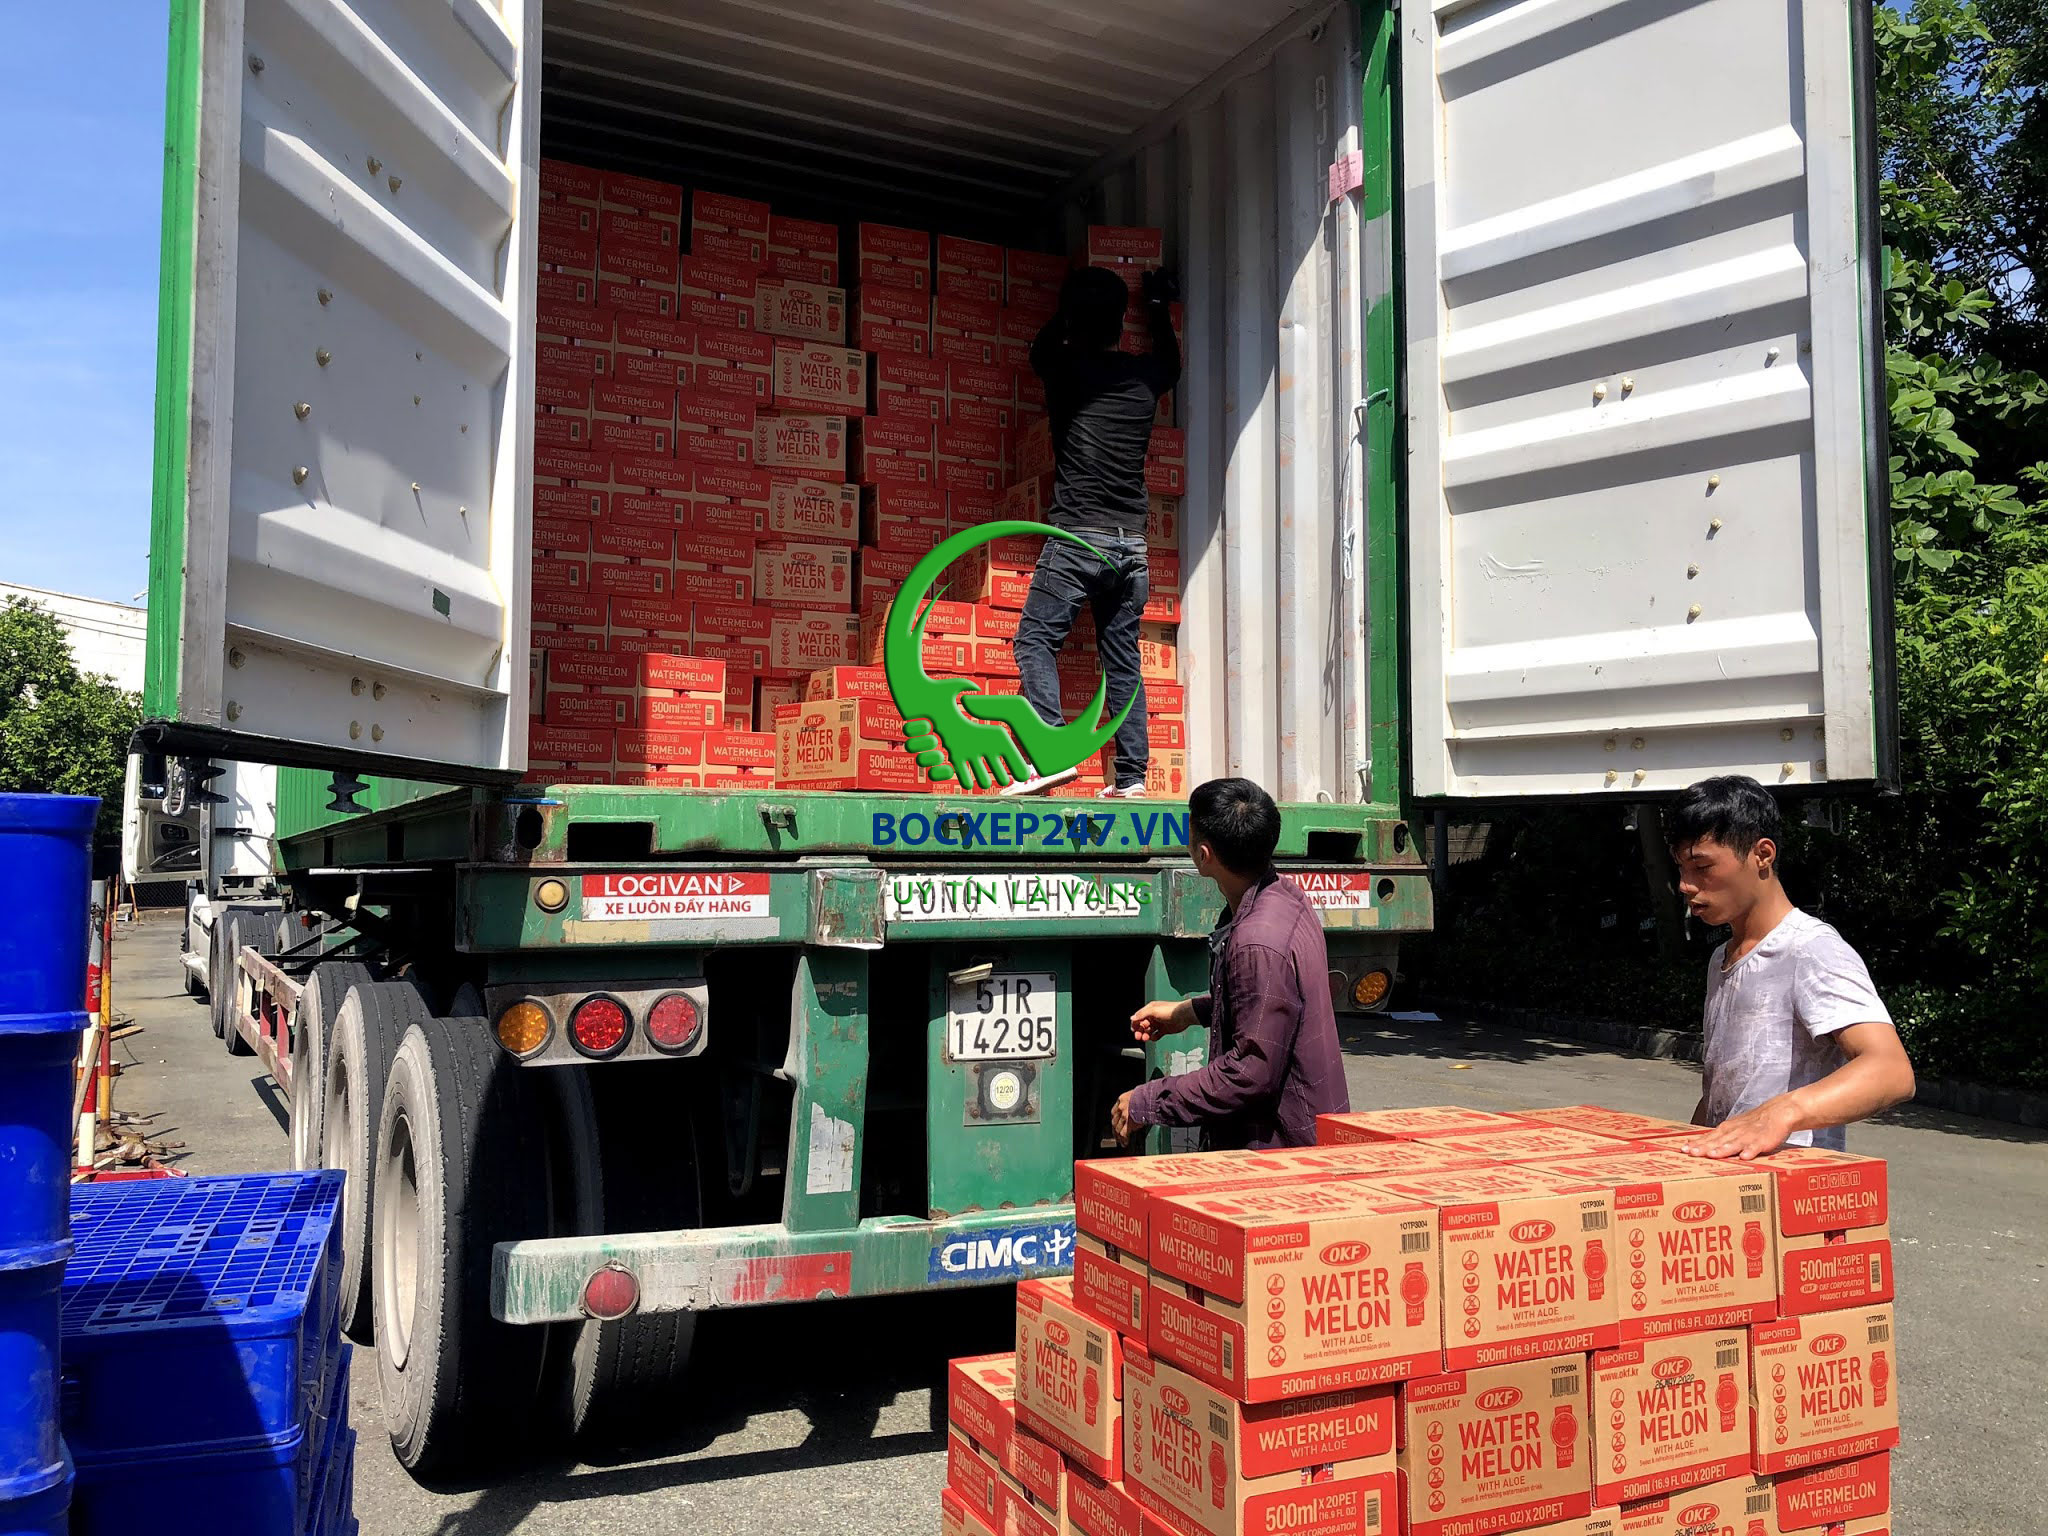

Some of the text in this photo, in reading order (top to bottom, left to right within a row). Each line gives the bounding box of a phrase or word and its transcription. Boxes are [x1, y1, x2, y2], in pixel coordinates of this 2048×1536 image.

[612, 186, 672, 206] WATERMELON
[701, 206, 760, 224] WATERMELON
[775, 229, 832, 246] WATERMELON
[869, 236, 923, 252] WATERMELON
[1099, 238, 1155, 249] WATERMELON
[870, 298, 922, 315] WATERMELON
[540, 315, 604, 333] WATERMELON
[625, 328, 687, 345] WATERMELON
[705, 340, 764, 357] WATERMELON
[627, 359, 653, 371] 500ml
[800, 362, 841, 379] WATER
[801, 374, 842, 391] MELON
[887, 366, 940, 382] WATERMELON
[602, 393, 665, 410] WATERMELON
[872, 430, 926, 444] WATERMELON
[623, 467, 685, 483] WATERMELON
[702, 476, 762, 492] WATERMELON
[623, 498, 650, 511] 500ml
[601, 534, 664, 551] WATERMELON
[782, 562, 826, 578] WATER
[782, 576, 826, 589] MELON
[620, 608, 682, 623] WATERMELON
[703, 615, 764, 630] WATERMELON
[559, 663, 628, 677] WATERMELON
[649, 669, 714, 683] WATERMELON
[652, 702, 680, 714] 500ml
[796, 728, 833, 747] WATER
[625, 743, 692, 756] WATERMELON
[713, 746, 776, 759] WATERMELON
[796, 746, 833, 764] MELON
[869, 755, 895, 769] 500ml
[604, 875, 722, 896] LOGIVAN
[1286, 874, 1337, 890] IVAN
[605, 902, 624, 915] XE
[628, 899, 671, 914] LUÔN
[709, 898, 751, 912] HÀNG
[1330, 895, 1343, 905] UY
[977, 979, 1032, 1014] 51R
[956, 1016, 1053, 1056] 142.95
[996, 1085, 1014, 1094] 12/20
[1616, 1192, 1658, 1205] IMPORTED
[1793, 1190, 1878, 1216] WATERMELON
[1081, 1195, 1142, 1239] WATERMELON
[1448, 1211, 1494, 1226] IMPORTED
[1617, 1209, 1659, 1221] www.okf.kr
[1680, 1204, 1707, 1220] OKF
[1816, 1210, 1857, 1224] WITH ALOE
[1252, 1232, 1303, 1248] IMPORTED
[1449, 1229, 1495, 1243] www.okf.kr
[1518, 1223, 1547, 1240] OKF
[1658, 1225, 1733, 1257] WATER
[941, 1235, 1037, 1272] CIMC
[1159, 1231, 1234, 1278] WATERMELON
[1253, 1250, 1303, 1266] www.okf.kr
[1329, 1244, 1361, 1263] OKF
[1176, 1259, 1213, 1283] WITH ALOE
[1494, 1245, 1574, 1280] WATER
[1661, 1252, 1734, 1286] MELON
[1800, 1253, 1865, 1282] 500ml 20PET
[1083, 1261, 1109, 1293] 500ml
[1301, 1267, 1390, 1306] WATER
[1497, 1274, 1575, 1311] MELON
[1676, 1283, 1720, 1296] WITH ALOE
[1161, 1301, 1218, 1338] 500ml 20PET
[1305, 1299, 1391, 1337] MELON
[1512, 1306, 1559, 1321] WITH ALOE
[1643, 1308, 1753, 1335] 500ml 20PET
[1048, 1323, 1066, 1341] OKF
[1759, 1327, 1796, 1340] IMPORTED
[1321, 1333, 1373, 1349] WITH ALOE
[1476, 1347, 1508, 1364] 500ml
[1510, 1344, 1530, 1358] (16.9
[1531, 1342, 1541, 1353] FL
[1542, 1339, 1557, 1352] OZ)
[1564, 1333, 1594, 1350] 20PET
[1816, 1337, 1839, 1353] OKF
[1600, 1351, 1639, 1365] IMPORTED
[1760, 1343, 1797, 1357] www.okf.kr
[1035, 1337, 1077, 1387] WATER
[1659, 1361, 1685, 1377] OKF
[1281, 1376, 1316, 1395] 500ml
[1318, 1373, 1341, 1389] (16.9
[1342, 1371, 1353, 1383] FL
[1355, 1367, 1370, 1383] OZ)
[1379, 1360, 1413, 1378] 20PET
[1600, 1367, 1639, 1383] www.okf.kr
[1797, 1356, 1862, 1391] WATER
[1035, 1365, 1077, 1413] MELON
[1414, 1381, 1461, 1397] IMPORTED
[1638, 1379, 1707, 1416] WATER
[1165, 1390, 1185, 1412] OKF
[1415, 1398, 1461, 1414] www.okf.kr
[1484, 1391, 1513, 1408] OKF
[1800, 1383, 1863, 1419] MELON
[954, 1391, 995, 1438] WATERMELON
[1150, 1402, 1202, 1462] WATER
[1258, 1412, 1379, 1452] WATERMELON
[1458, 1411, 1541, 1450] WATER
[1640, 1407, 1708, 1446] MELON
[1290, 1438, 1348, 1459] WITH ALOE
[1653, 1439, 1695, 1455] WITH ALOE
[1152, 1434, 1203, 1493] MELON
[1462, 1441, 1542, 1482] MELON
[1477, 1475, 1526, 1493] WITH ALOE
[1623, 1463, 1727, 1499] 500ml 20PET
[1788, 1480, 1877, 1512] WATERMELON
[1265, 1490, 1359, 1532] 500ml X 20PET
[1441, 1502, 1564, 1536] 500ml 20PET
[1685, 1506, 1711, 1524] OKF
[1811, 1503, 1854, 1519] WITH ALOE
[1623, 1515, 1664, 1531] www.okf.kr
